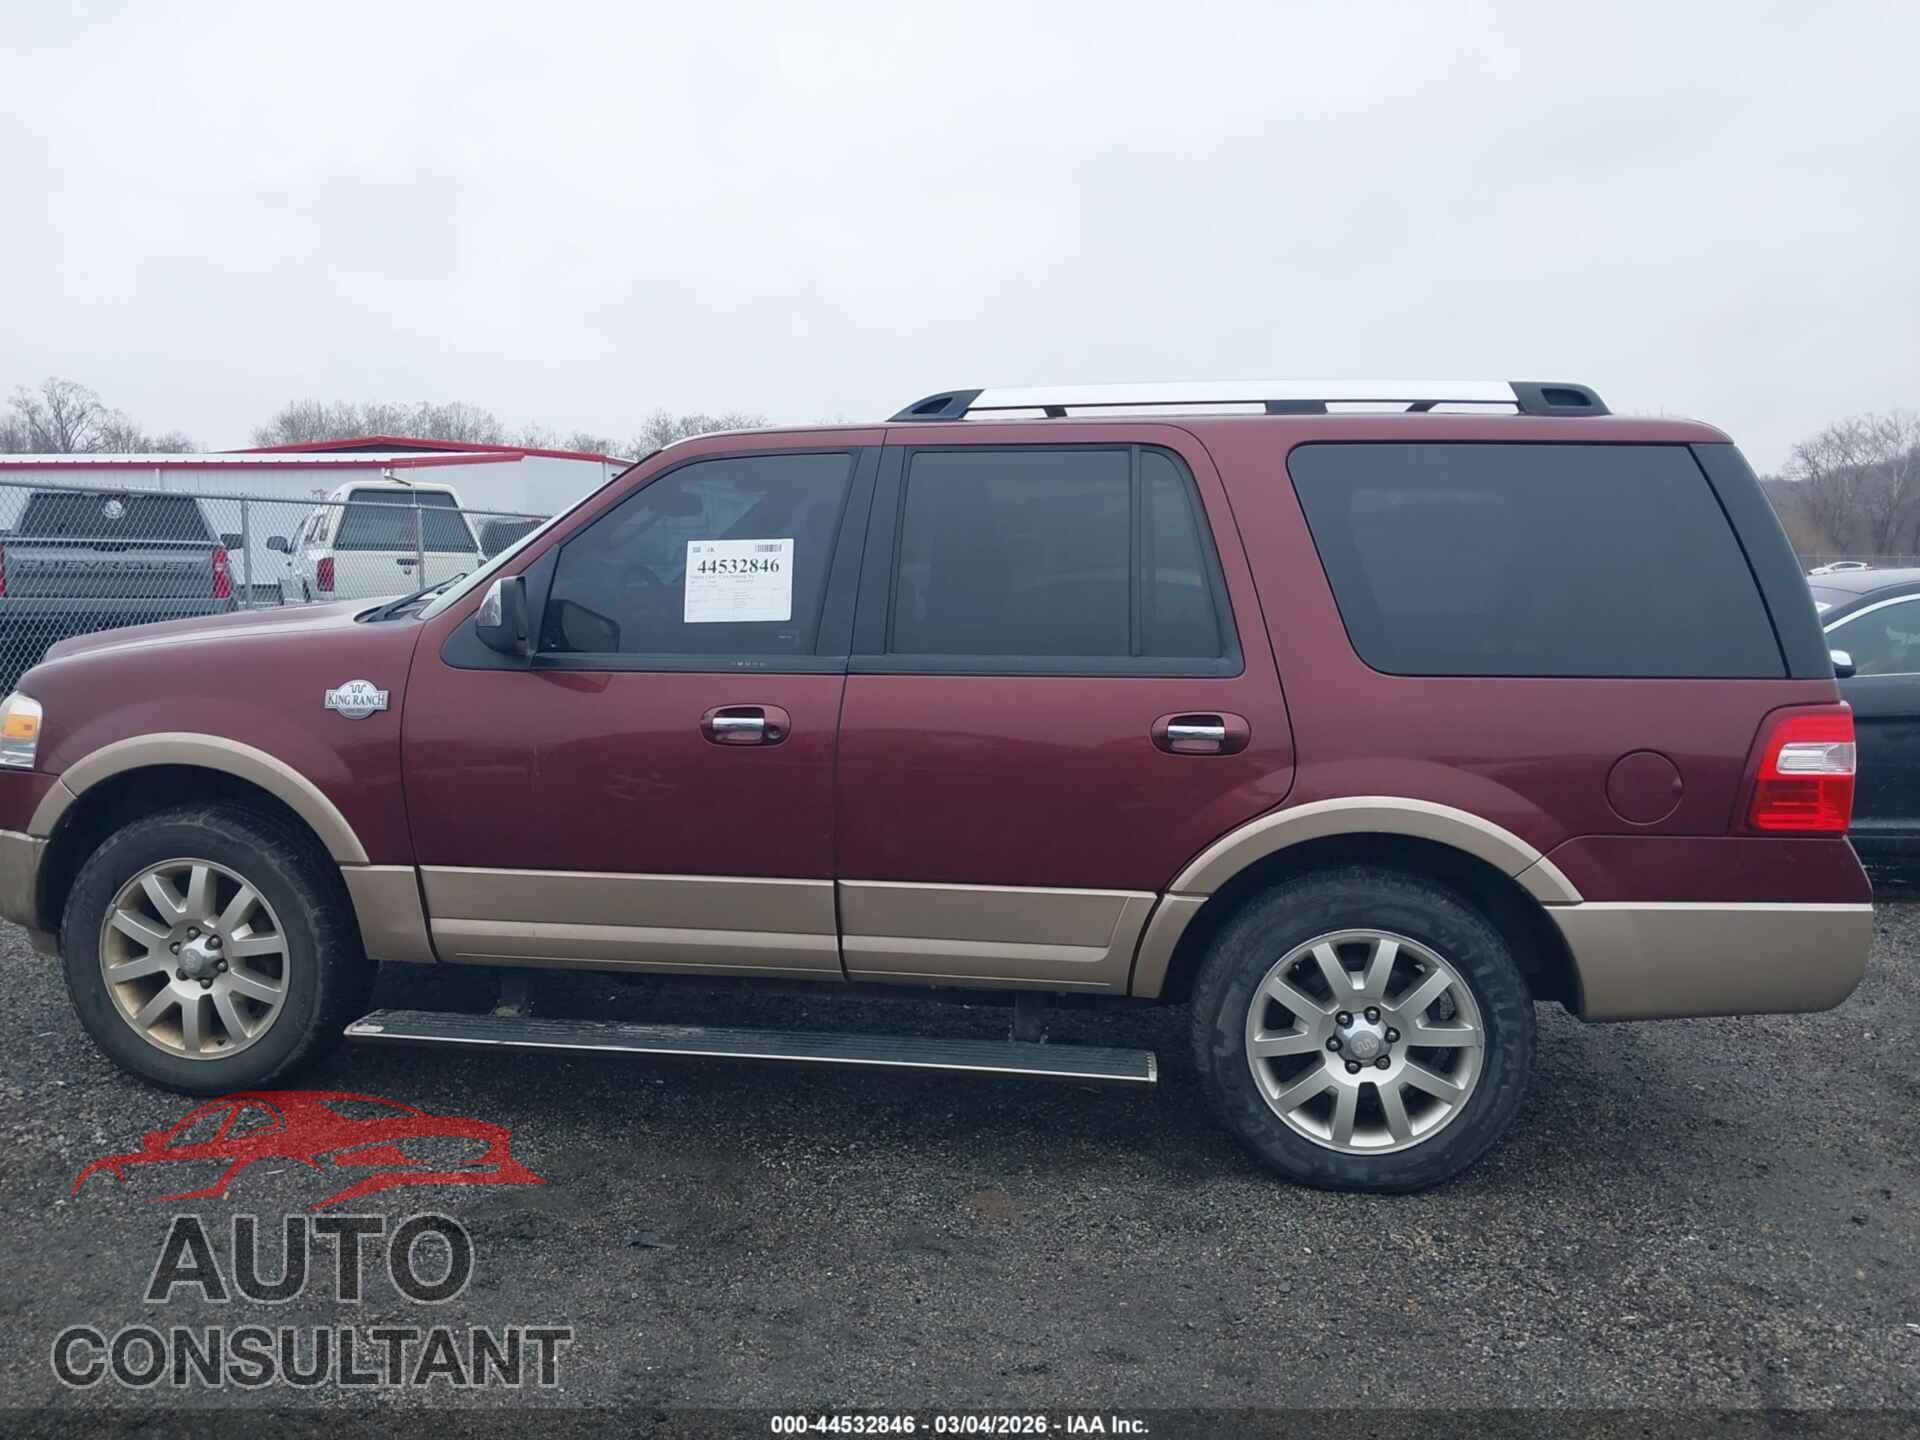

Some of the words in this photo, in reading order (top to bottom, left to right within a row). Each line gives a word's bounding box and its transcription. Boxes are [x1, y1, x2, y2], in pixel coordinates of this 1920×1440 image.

[697, 558, 780, 574] 44532846
[328, 692, 351, 705] KING
[352, 693, 385, 706] RANCH
